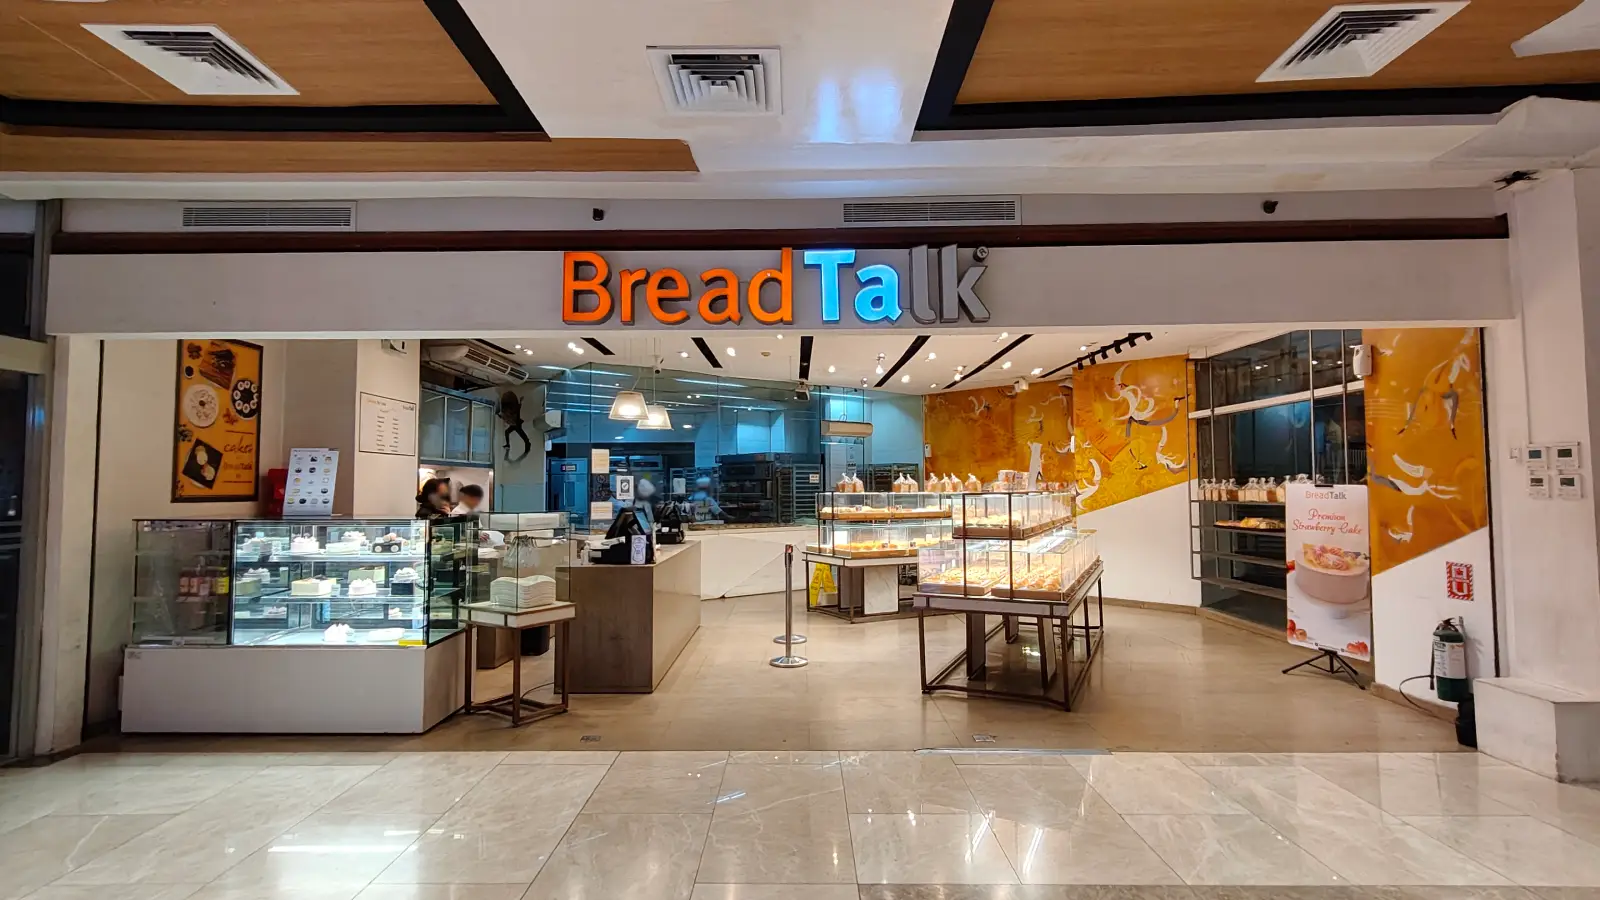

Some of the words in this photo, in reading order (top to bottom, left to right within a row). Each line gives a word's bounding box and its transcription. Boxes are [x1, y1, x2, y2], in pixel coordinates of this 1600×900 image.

[1305, 490, 1347, 500] BreadTalk
[1308, 508, 1346, 521] Premium
[1292, 519, 1336, 535] Strawberry
[1338, 522, 1363, 535] Cake
